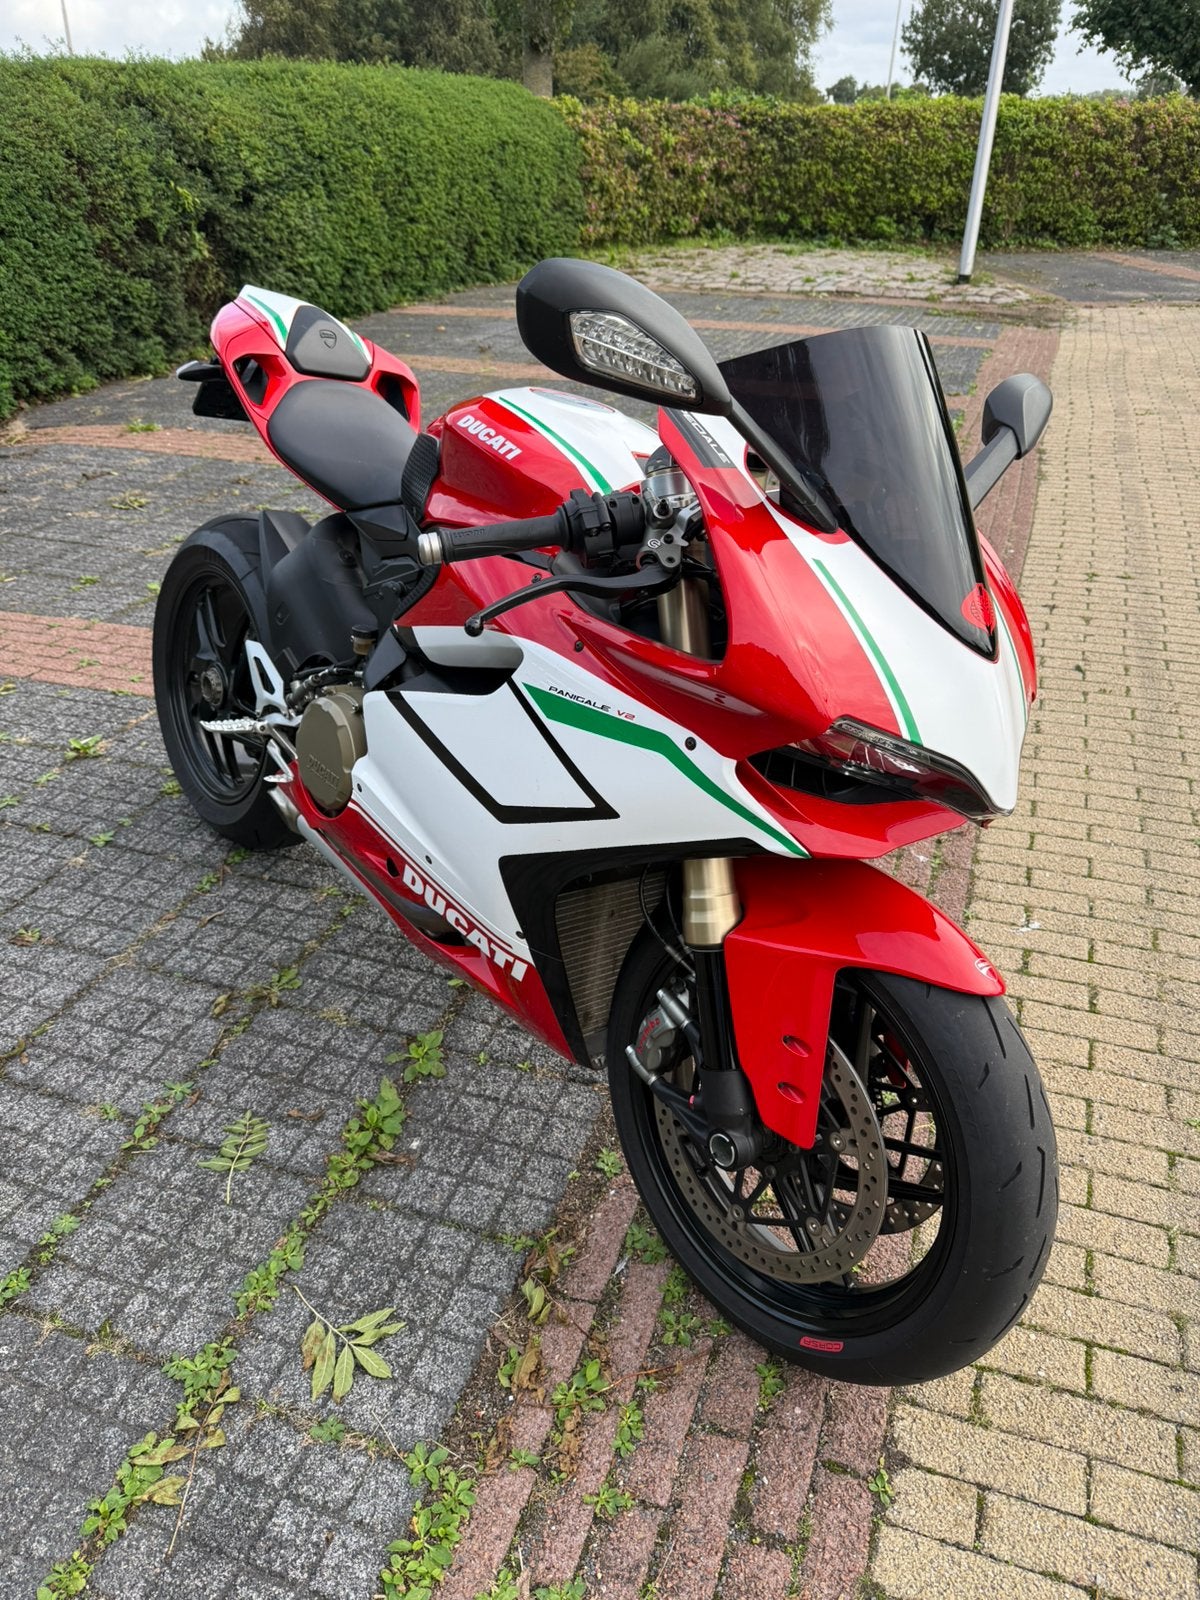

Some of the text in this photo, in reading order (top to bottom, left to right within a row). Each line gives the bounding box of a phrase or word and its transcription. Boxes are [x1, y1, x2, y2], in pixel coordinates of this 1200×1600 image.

[457, 414, 522, 461] DUCATI
[548, 685, 636, 721] PANIGALE V2
[403, 863, 529, 982] DUCATI
[803, 1338, 841, 1351] CORSA
